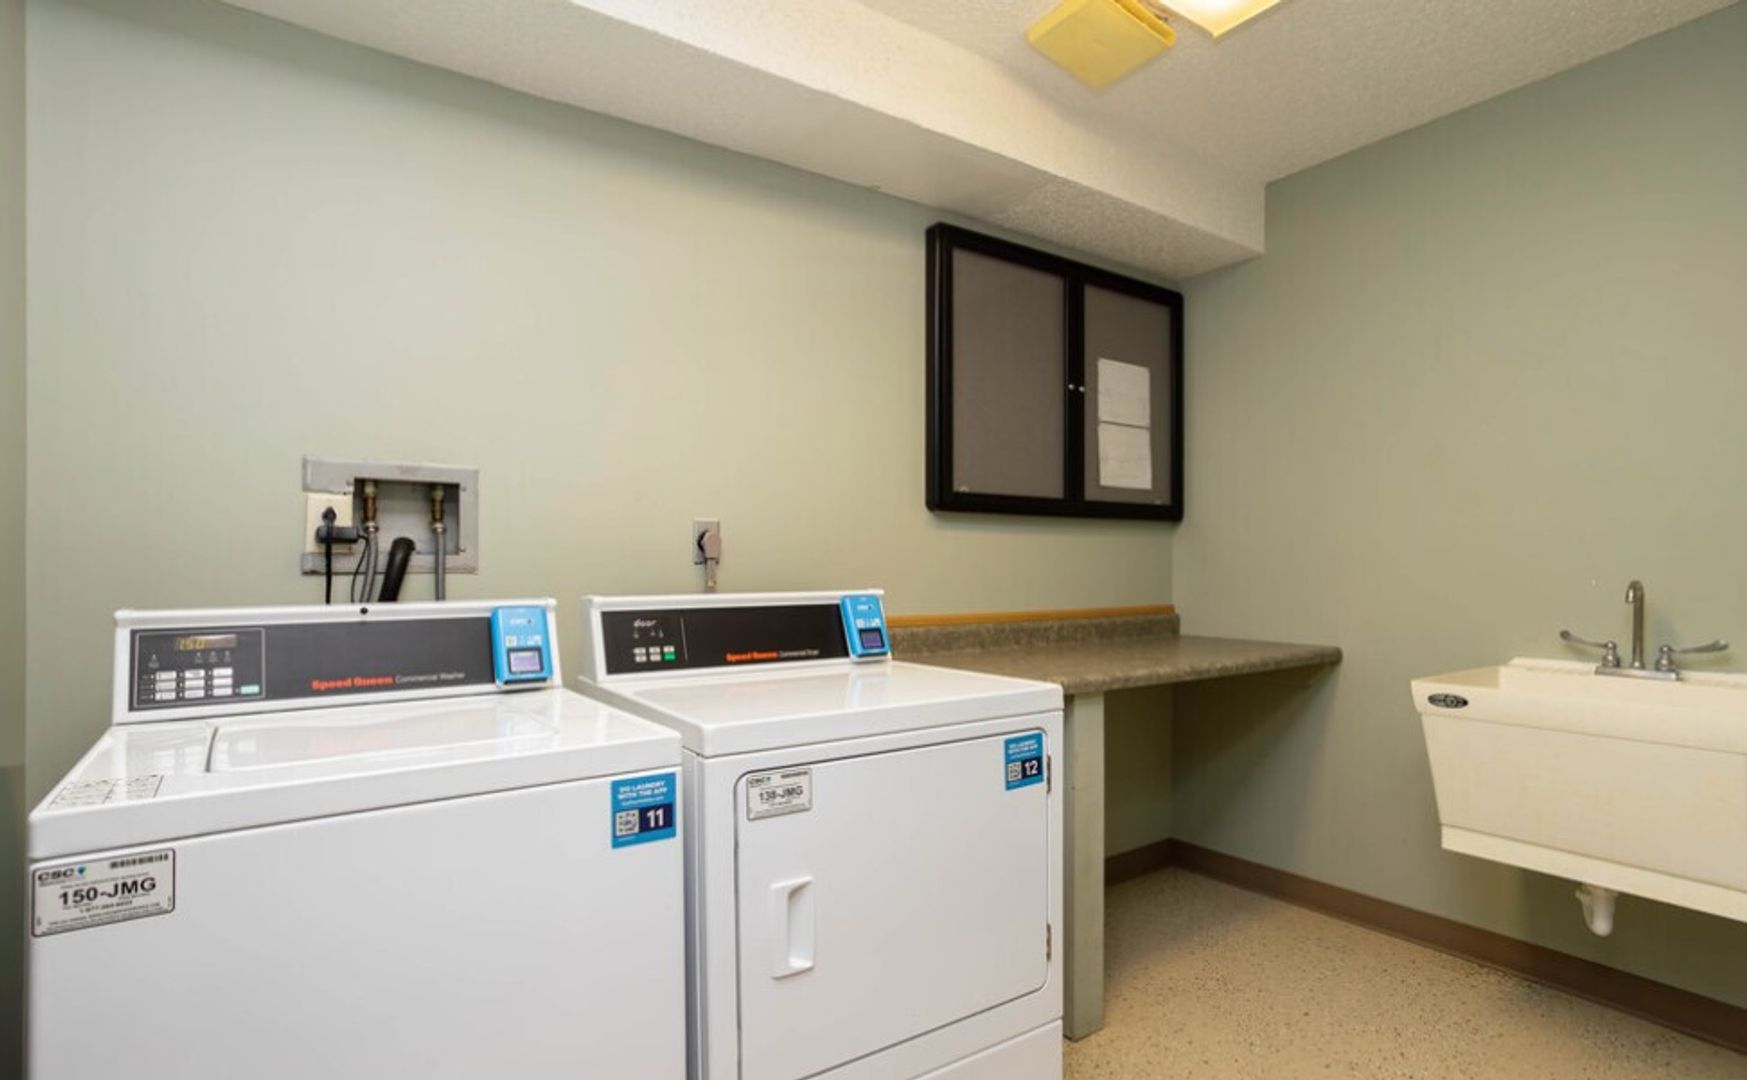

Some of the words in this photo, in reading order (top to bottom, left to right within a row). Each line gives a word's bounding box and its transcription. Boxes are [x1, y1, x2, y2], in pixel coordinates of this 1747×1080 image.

[633, 619, 656, 628] door
[311, 678, 352, 691] Speed
[353, 676, 394, 688] Queen
[395, 673, 438, 685] Commercial
[1024, 760, 1038, 776] 12
[632, 781, 665, 791] LAUNDRY
[647, 808, 664, 828] 11
[37, 867, 75, 882] CSC
[58, 876, 156, 905] 150-JMG
